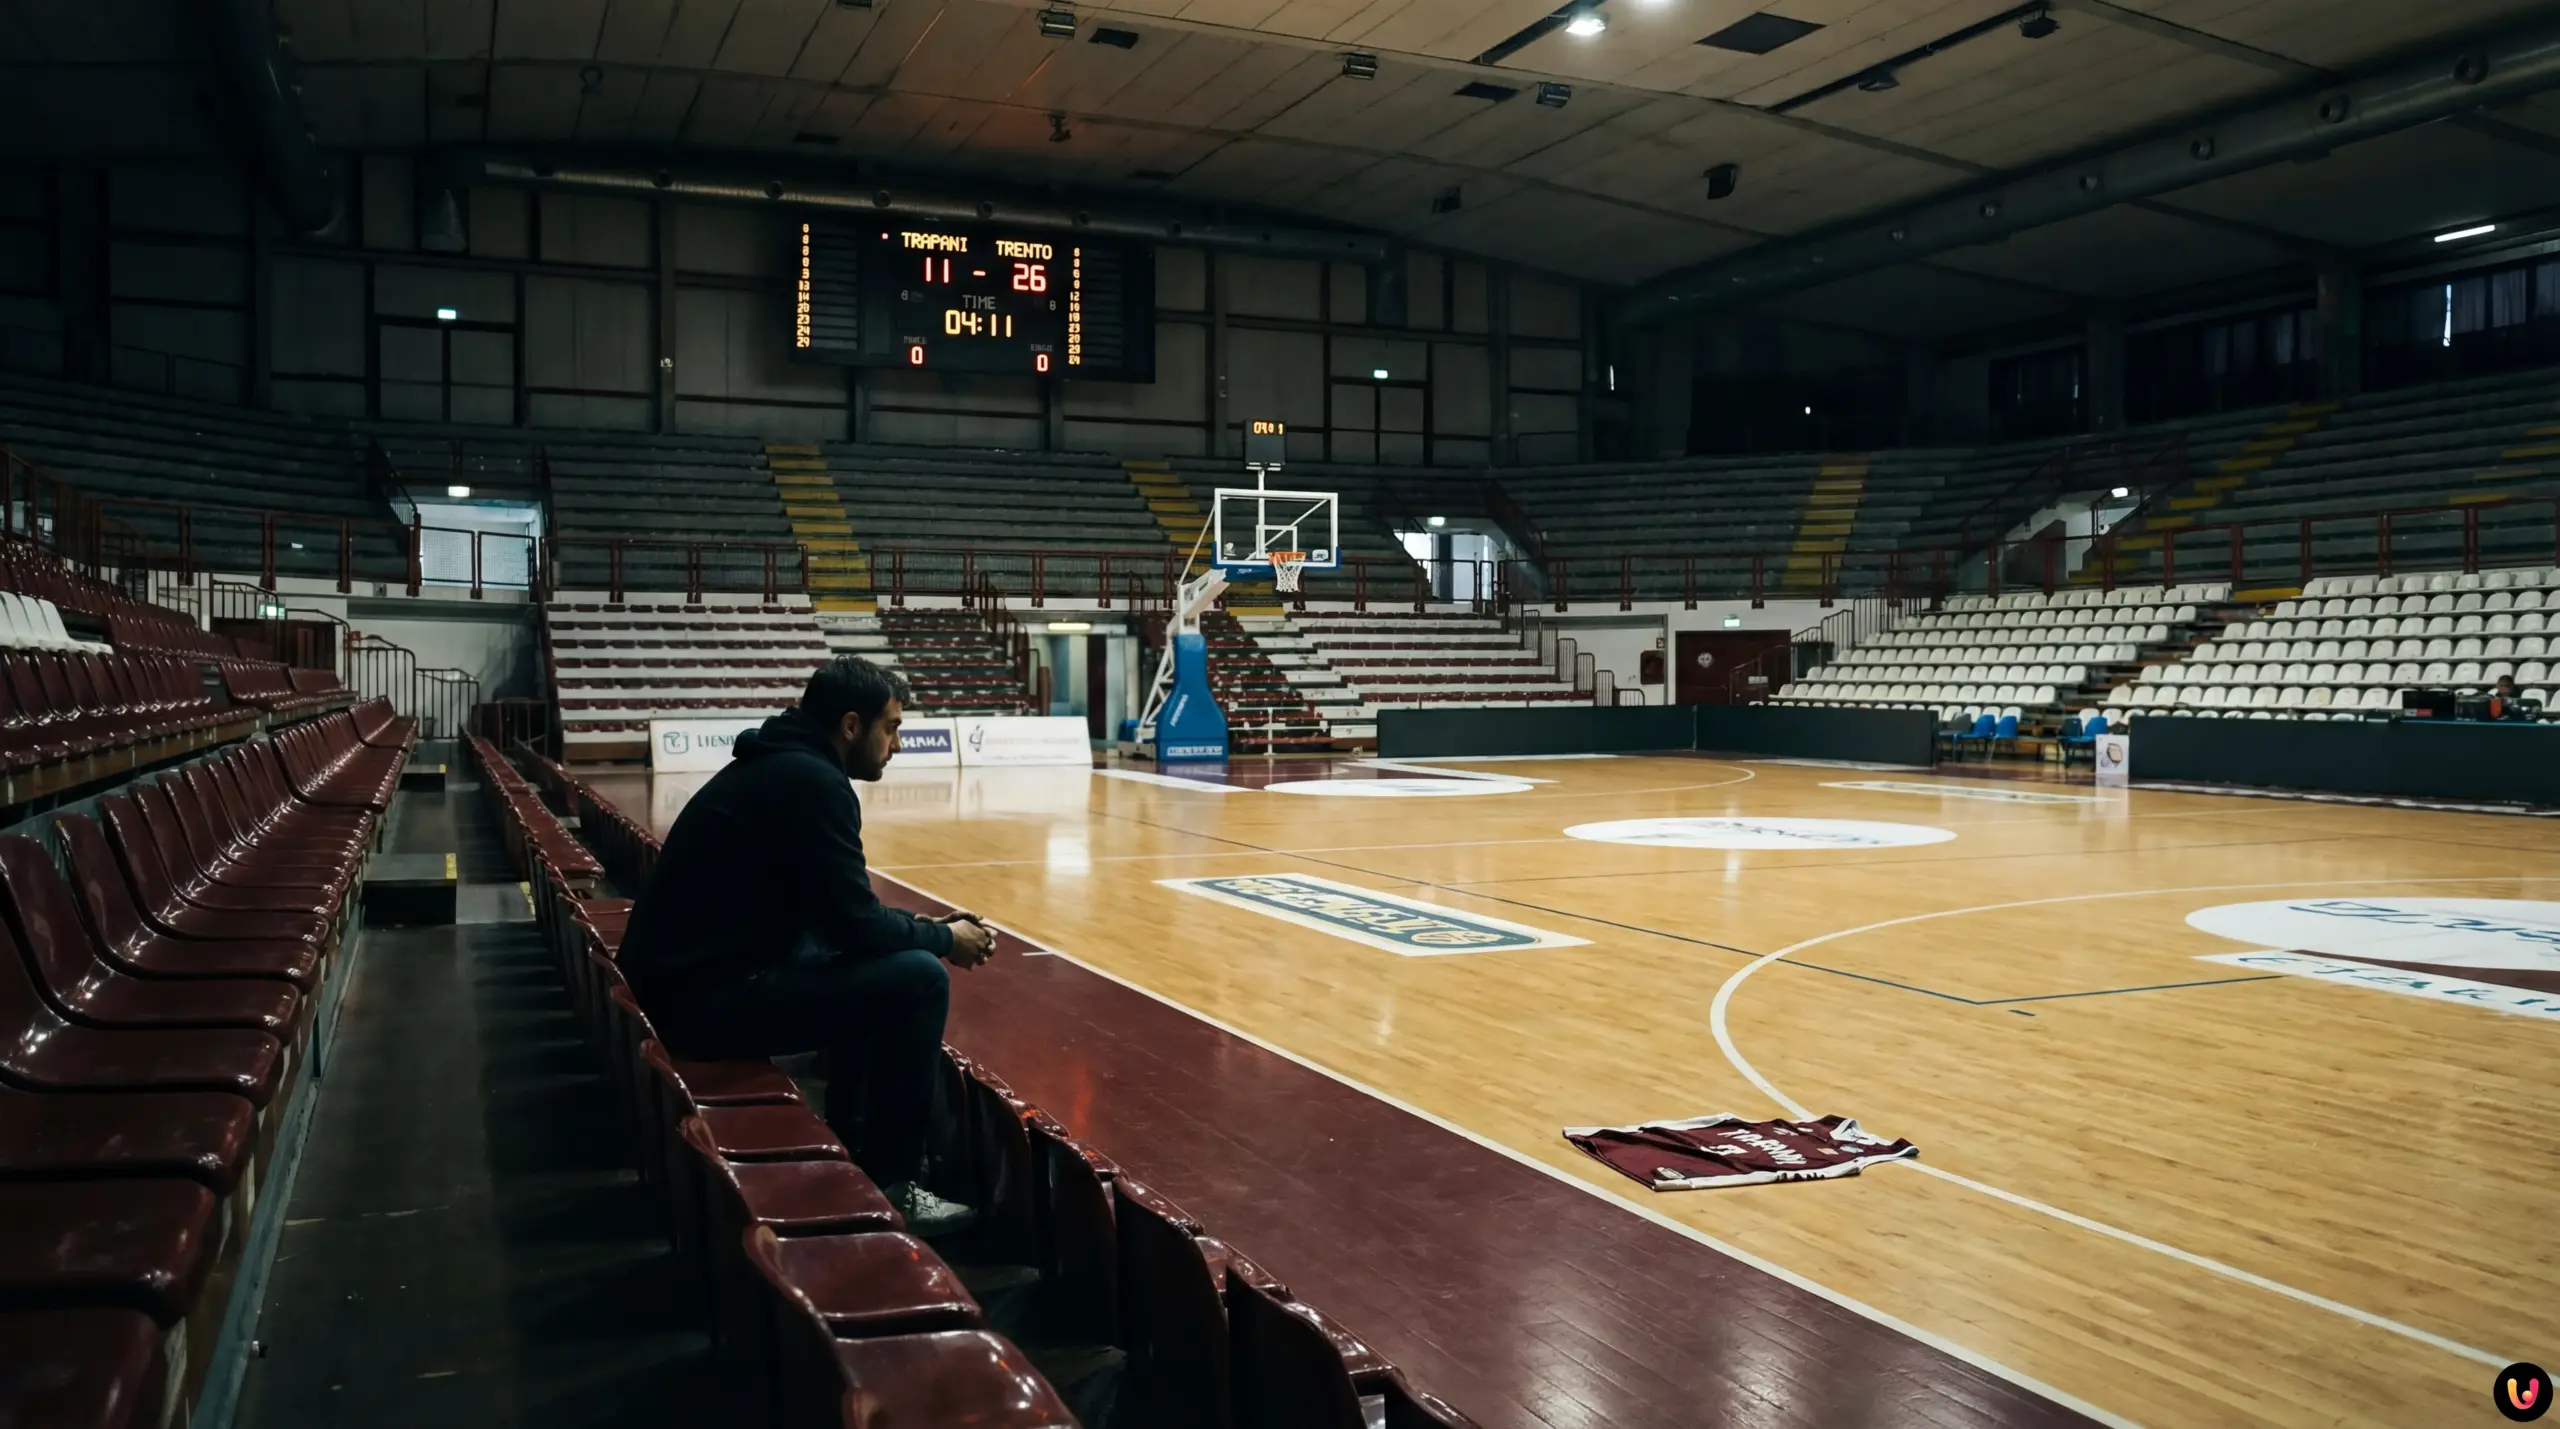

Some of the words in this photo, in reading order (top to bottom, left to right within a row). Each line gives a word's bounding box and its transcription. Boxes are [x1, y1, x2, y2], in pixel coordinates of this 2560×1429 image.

[901, 232, 968, 252] TRAPANI
[996, 240, 1053, 260] TRENTO
[925, 256, 950, 283] 11
[1013, 263, 1047, 292] 26
[962, 294, 996, 310] TIME
[1070, 291, 1080, 301] 12
[797, 313, 810, 324] 23
[945, 309, 1012, 338] 04:11
[797, 336, 810, 347] 29
[911, 346, 923, 364] 0
[1037, 354, 1049, 372] 0
